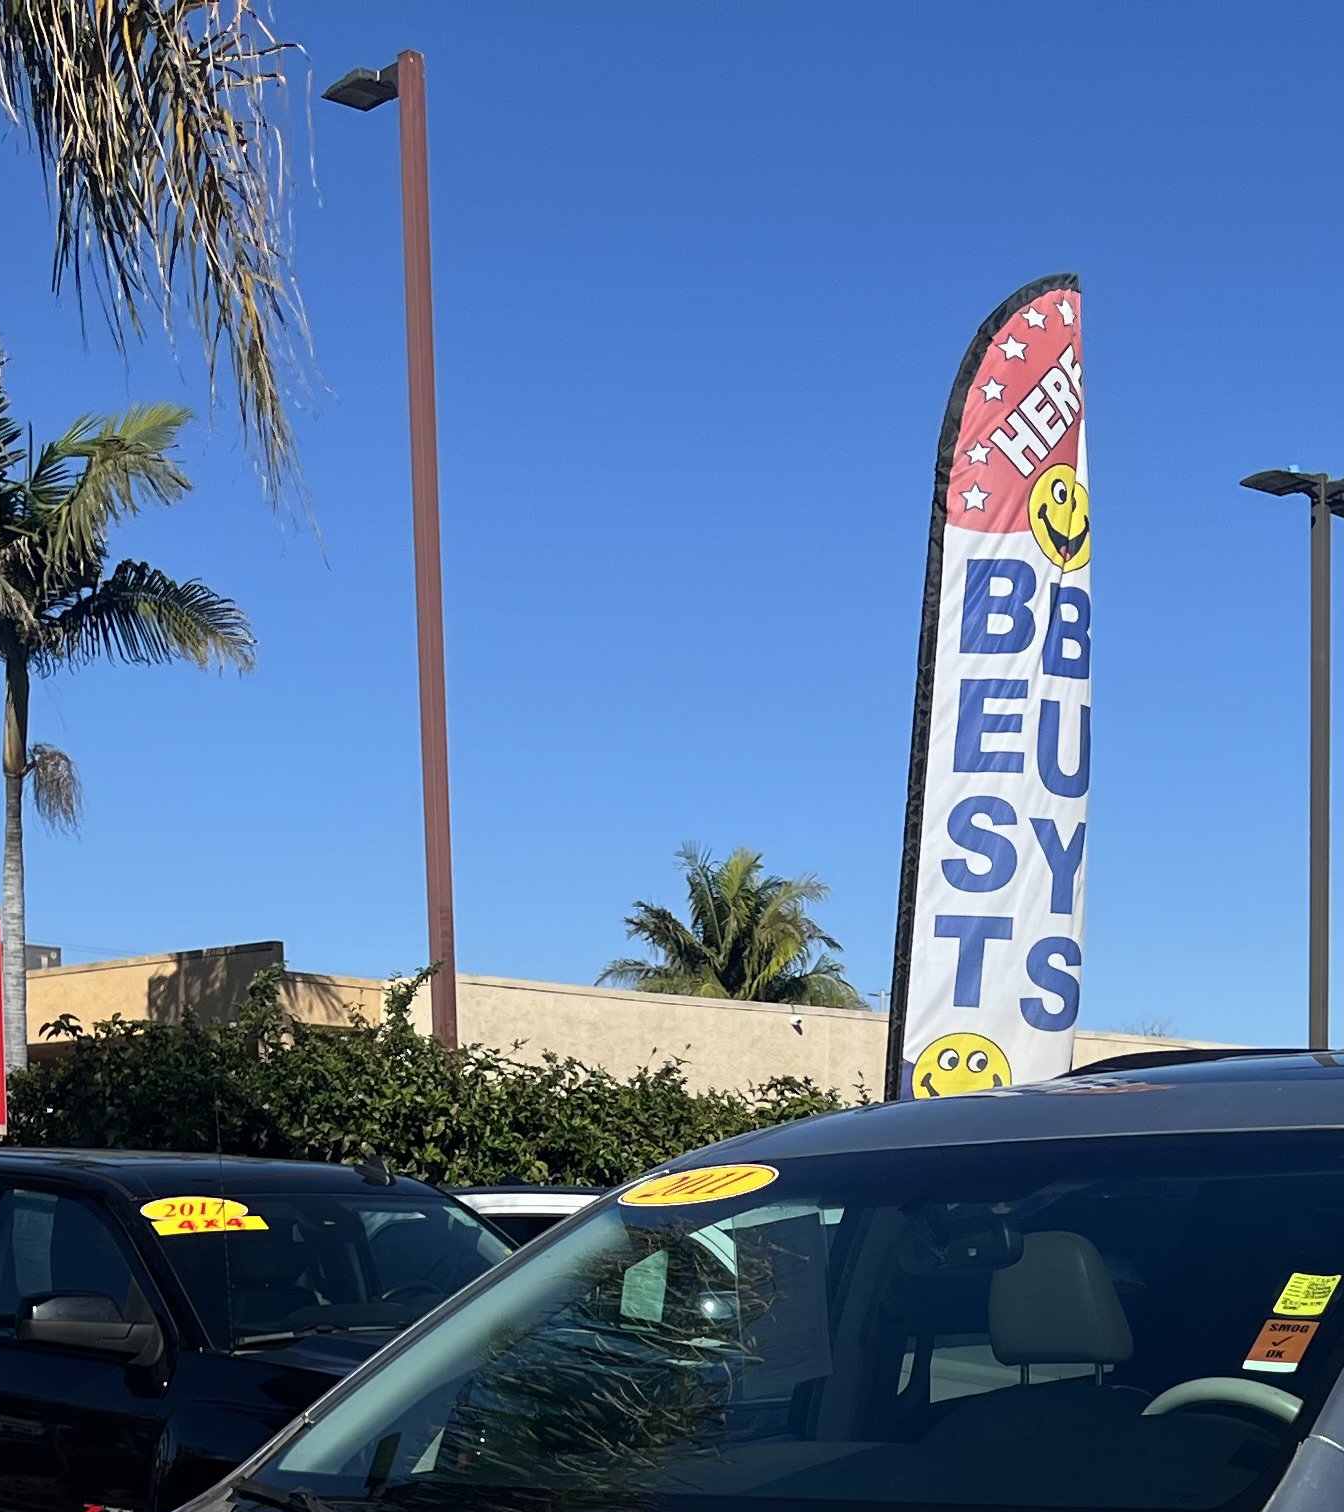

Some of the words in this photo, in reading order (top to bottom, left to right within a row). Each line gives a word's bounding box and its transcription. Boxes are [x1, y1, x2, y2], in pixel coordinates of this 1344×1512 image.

[934, 559, 1036, 1007] BEST
[1020, 582, 1091, 1032] BUYS
[163, 1202, 226, 1218] 2017
[1269, 1323, 1310, 1333] SMOG
[1266, 1350, 1285, 1359] OK
